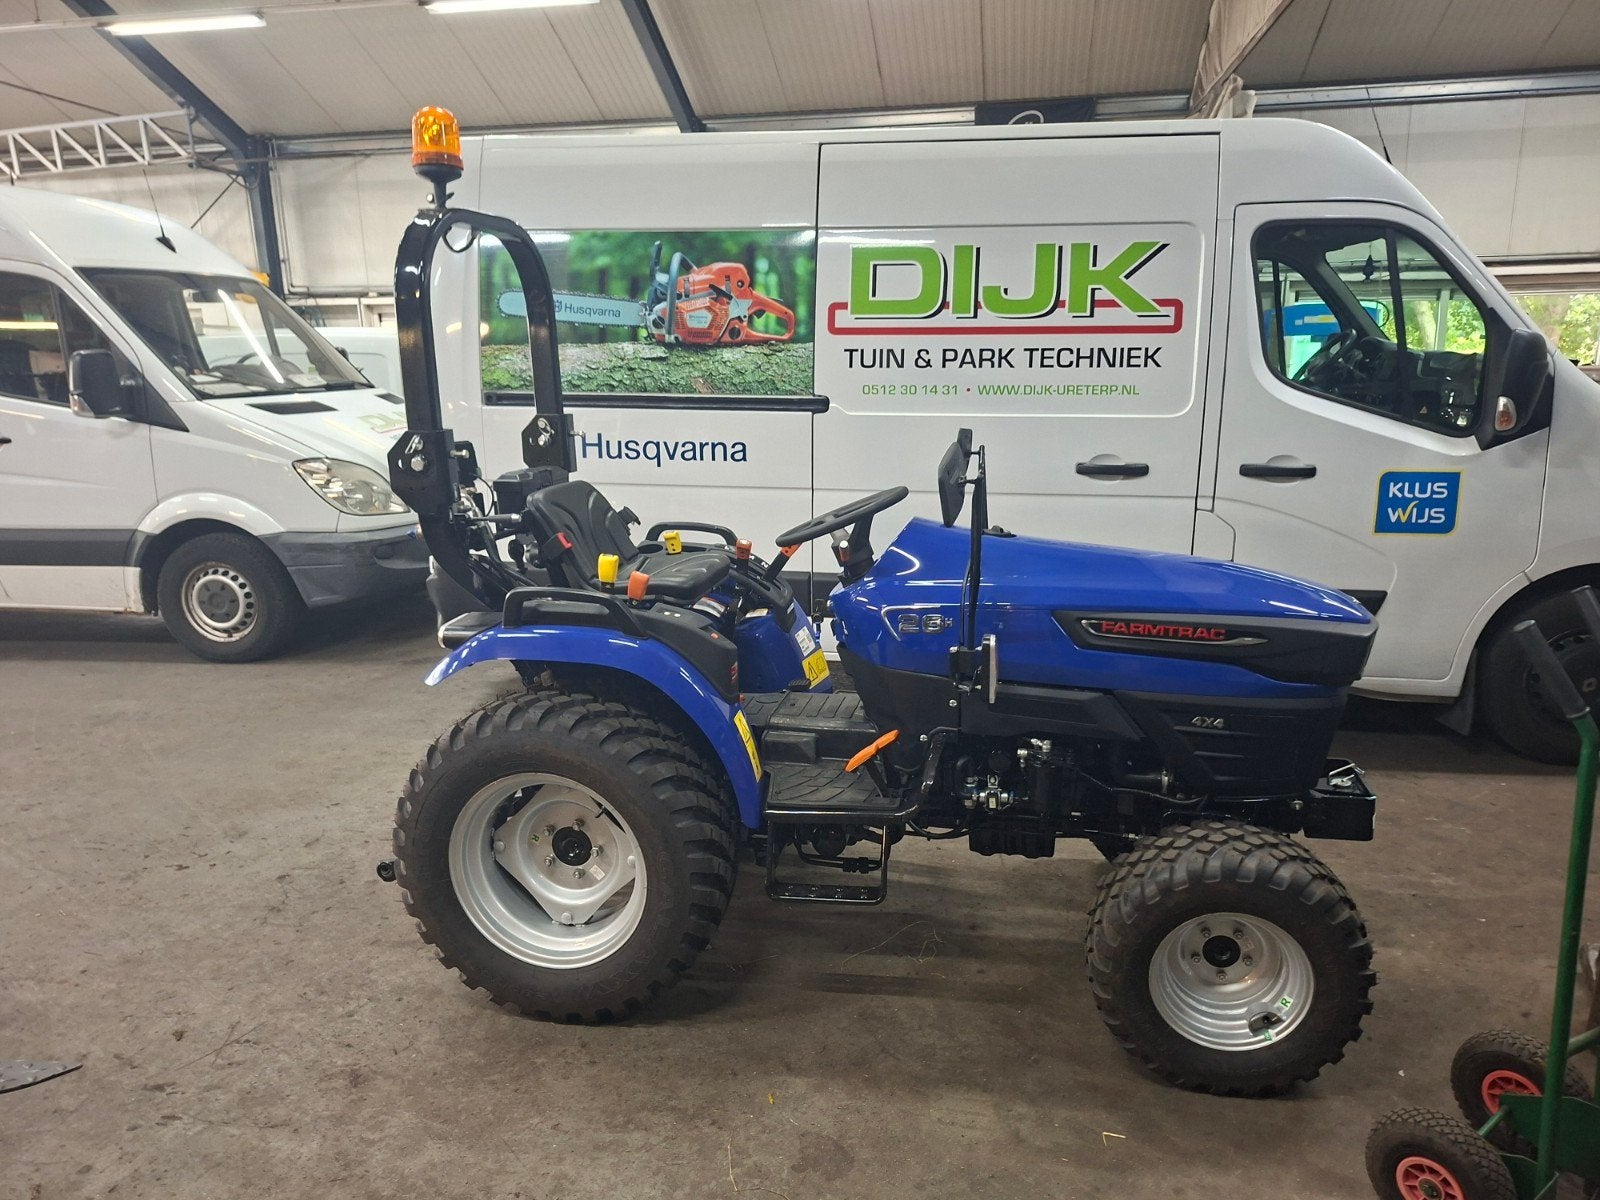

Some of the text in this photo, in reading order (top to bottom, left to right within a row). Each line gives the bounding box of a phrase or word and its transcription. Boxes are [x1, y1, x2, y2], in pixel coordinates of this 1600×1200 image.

[849, 241, 1171, 319] DIJK
[564, 302, 622, 318] Husqvarna
[844, 346, 1162, 369] TUIN & PARK TECHNIEK
[862, 384, 1140, 396] 0512 30 14 31 WWW.DIJK-URETERP.NL
[581, 432, 748, 467] Husqvarna
[1388, 482, 1449, 498] KLUS
[1387, 500, 1446, 523] WIJS
[1101, 620, 1227, 640] FARMTRAC
[1280, 997, 1291, 1008] R
